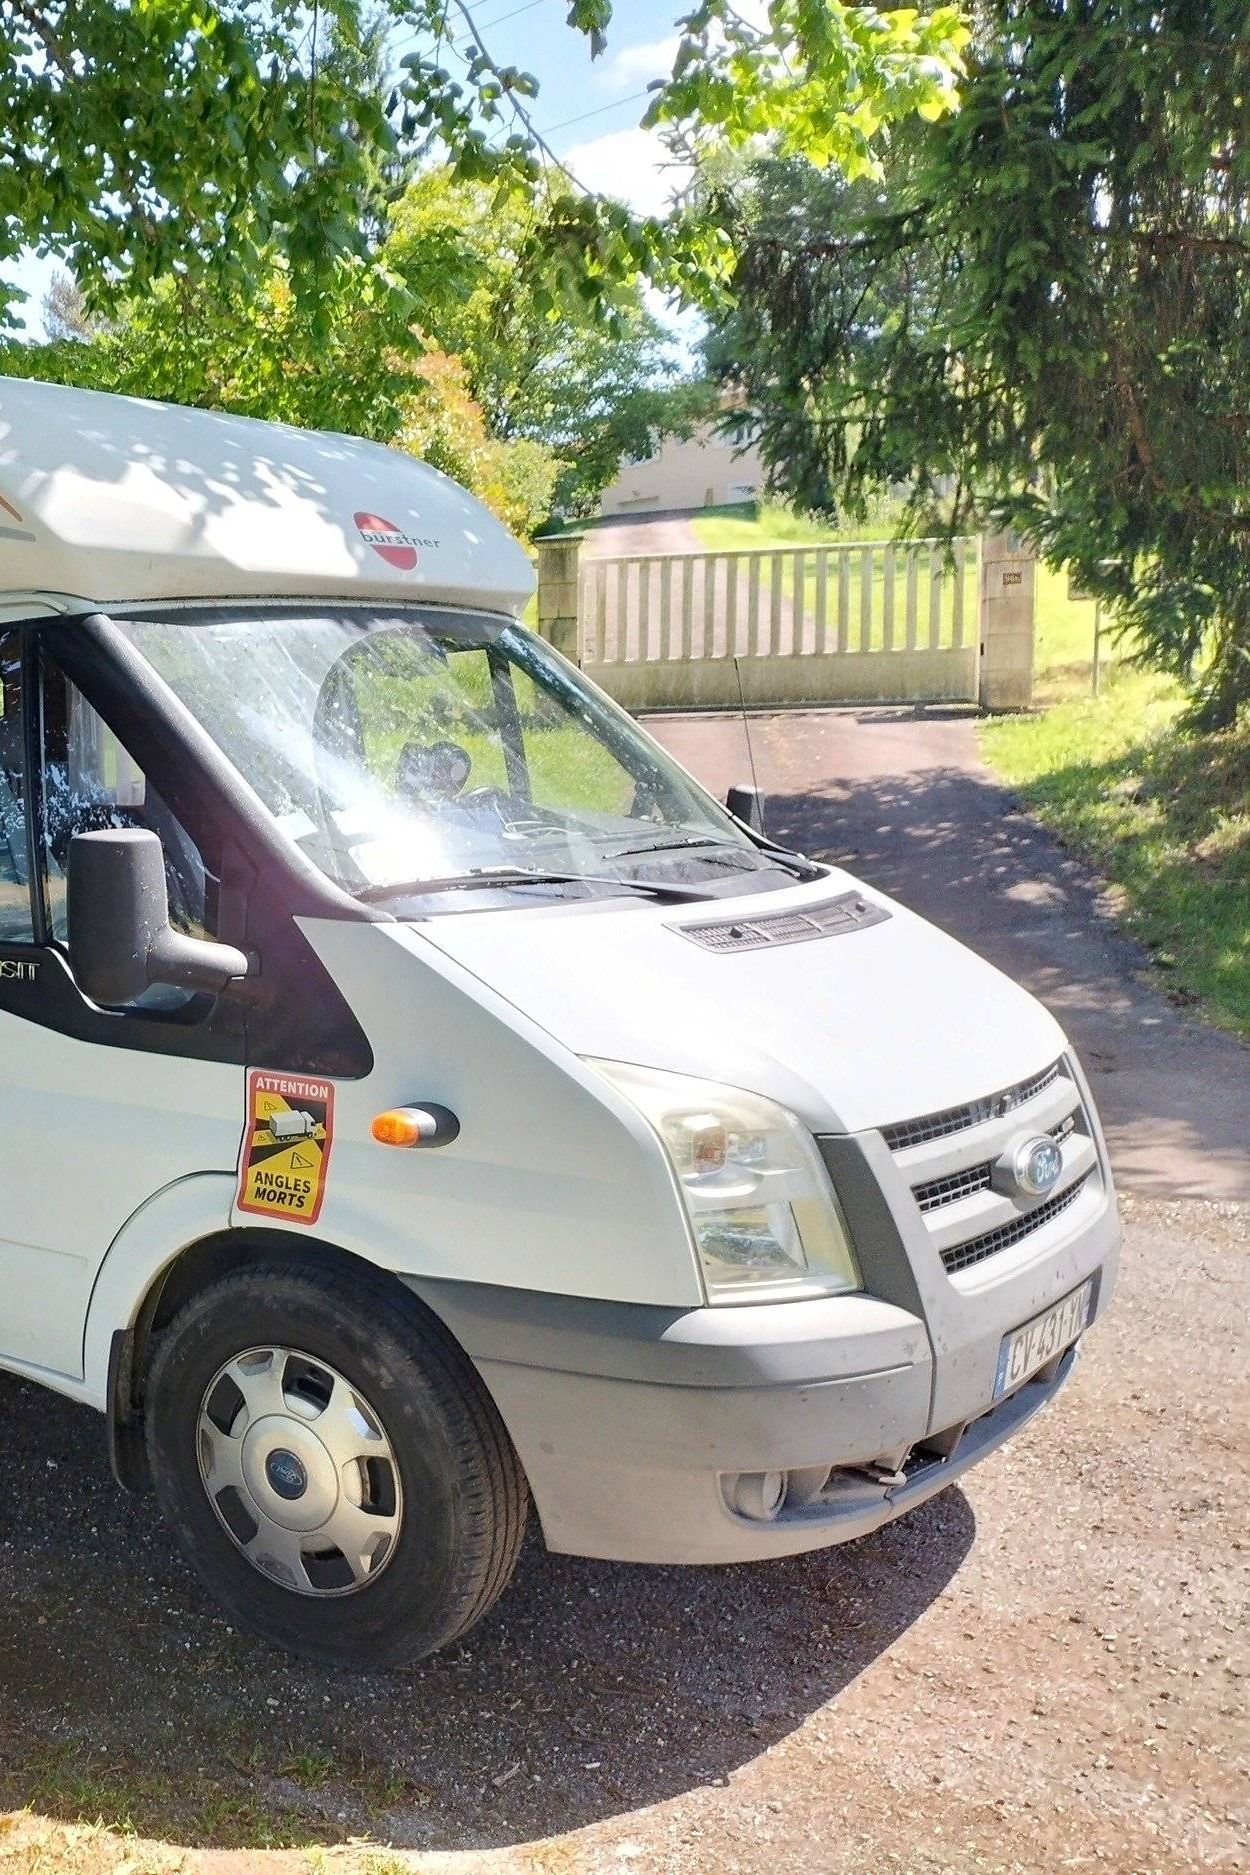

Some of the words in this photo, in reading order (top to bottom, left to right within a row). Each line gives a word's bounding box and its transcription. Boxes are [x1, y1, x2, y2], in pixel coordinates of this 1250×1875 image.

[359, 530, 440, 548] bürstner
[255, 1076, 329, 1099] ATTENTION
[253, 1170, 312, 1194] ANGLES
[253, 1186, 306, 1209] MORTS
